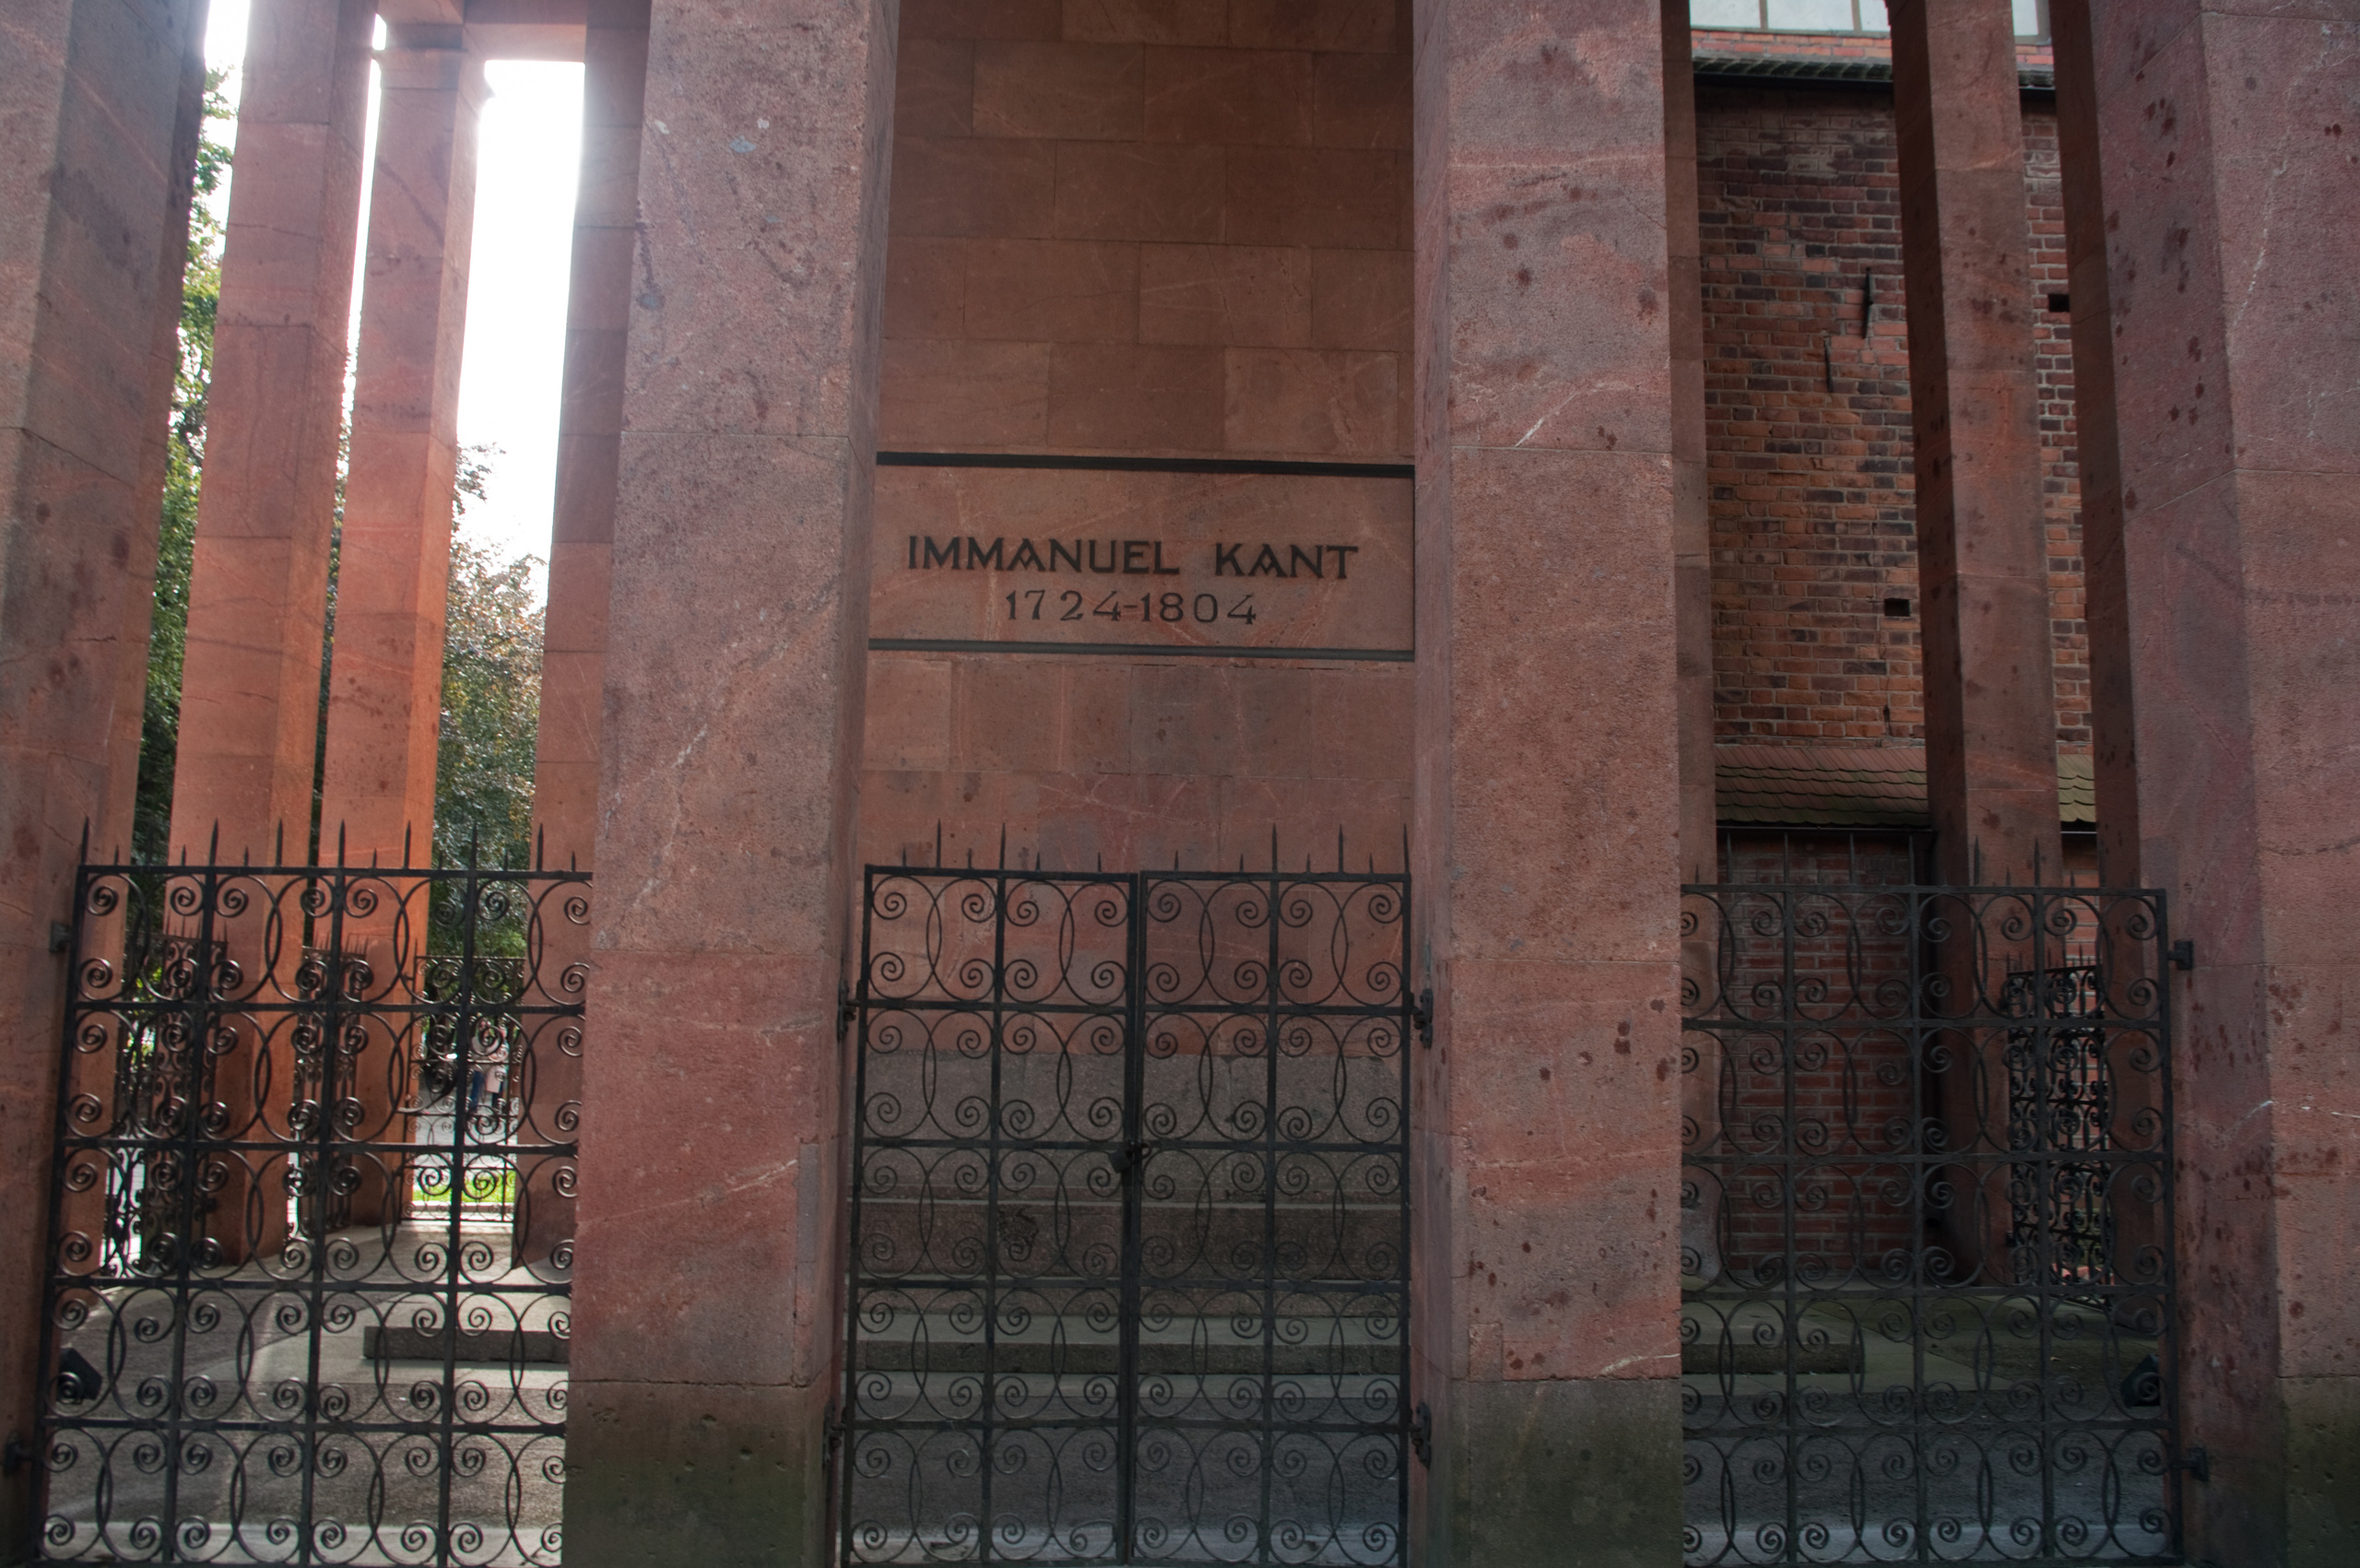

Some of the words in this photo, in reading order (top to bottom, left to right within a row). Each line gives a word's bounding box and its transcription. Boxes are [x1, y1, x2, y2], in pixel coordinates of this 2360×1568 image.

[908, 536, 1180, 575] IMMANUEL
[1215, 542, 1358, 579] KANT
[1007, 589, 1257, 625] 1724-1804
